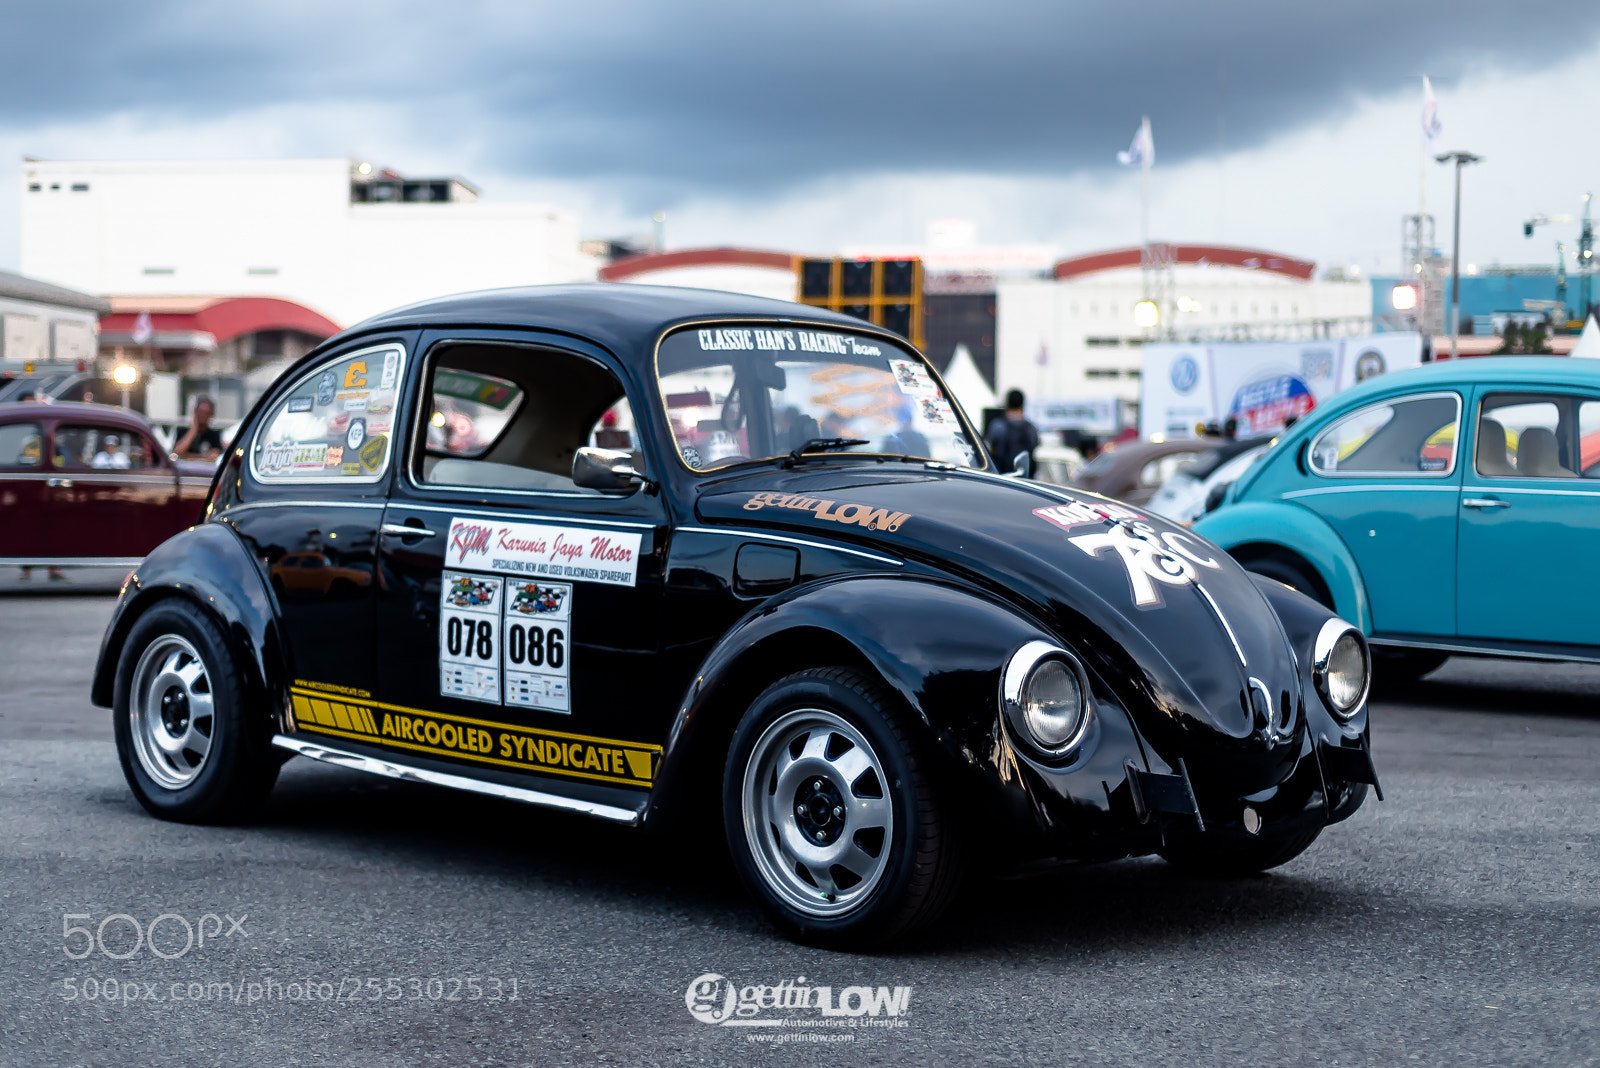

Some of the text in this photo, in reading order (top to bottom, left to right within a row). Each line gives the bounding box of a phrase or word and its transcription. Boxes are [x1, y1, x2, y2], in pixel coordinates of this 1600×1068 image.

[698, 329, 881, 357] CLASSIC HAN'S RACING Team
[498, 528, 547, 554] Karunia
[549, 533, 584, 562] Jaya
[590, 536, 632, 562] Motor
[492, 559, 632, 583] SPECIALIZING NEW AND USED VOLKSWAGEN SPAREPART
[447, 616, 492, 660] 078
[509, 623, 565, 669] 086
[382, 713, 625, 774] AIRCOOLED SYNDICATE
